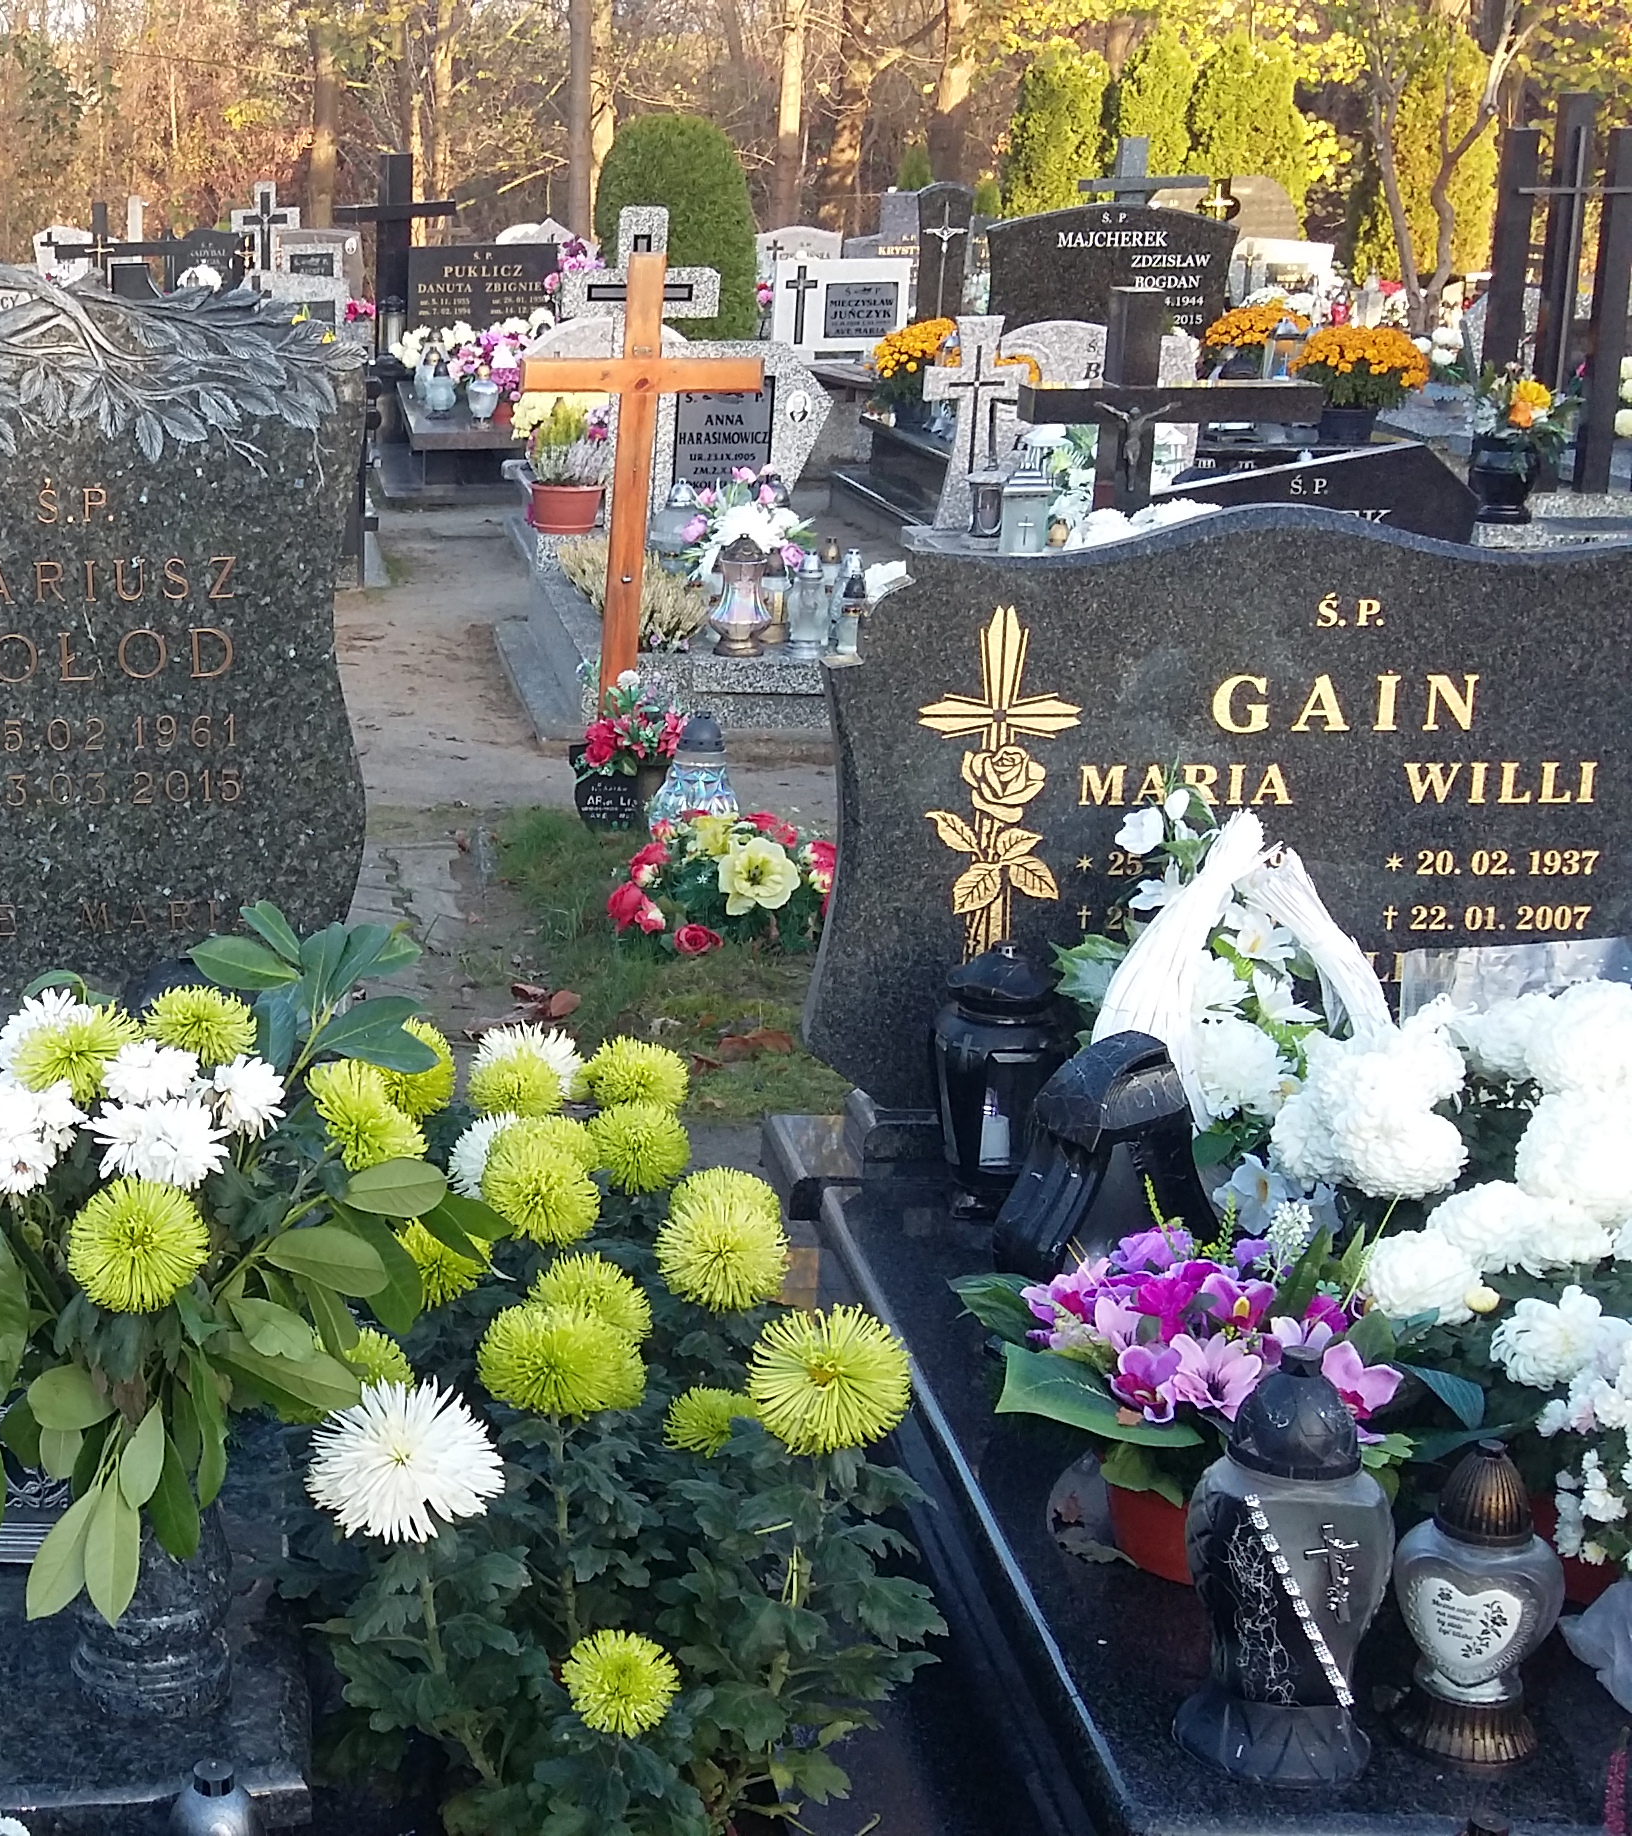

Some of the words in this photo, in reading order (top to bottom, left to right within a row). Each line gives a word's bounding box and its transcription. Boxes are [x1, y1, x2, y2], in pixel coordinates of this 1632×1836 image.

[1057, 231, 1168, 248] MAJCHEREK
[878, 246, 919, 256] KRYST
[1131, 254, 1211, 268] ZDZISŁAW
[443, 264, 523, 278] PUKLICZ
[418, 283, 472, 293] DANUTA
[485, 281, 542, 293] ZBIGNIE
[1135, 275, 1201, 289] BOGDAN
[830, 308, 891, 320] JUŃCZYK
[1173, 314, 1203, 325] 2015
[704, 414, 744, 426] ANNA
[1290, 474, 1307, 495] Ś.
[1313, 478, 1328, 495] P.
[1317, 592, 1346, 628] Ś.
[1357, 598, 1384, 627] P.
[1212, 673, 1480, 734] GAIN
[1078, 763, 1293, 806] MARIA
[1404, 761, 1599, 804] WILLI
[1416, 850, 1461, 877] 20.
[1471, 850, 1516, 877] 02.
[1528, 849, 1601, 877] 1937
[1409, 906, 1455, 932] 22.
[1464, 906, 1506, 932] 01.
[1515, 905, 1593, 932] 2007
